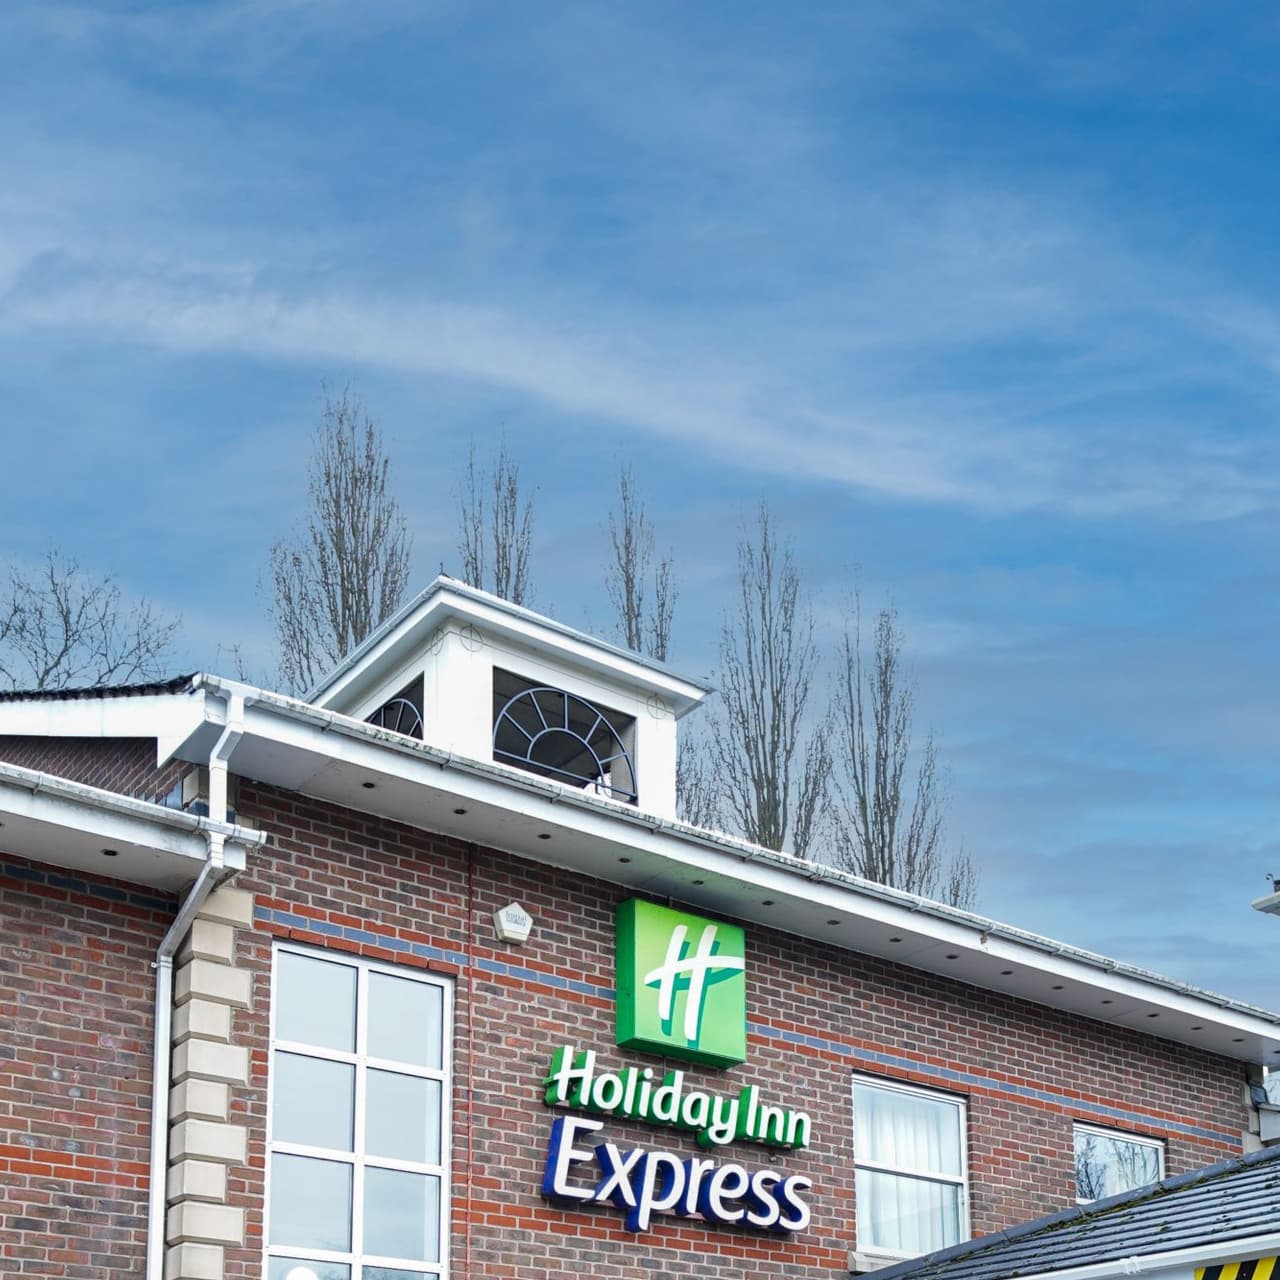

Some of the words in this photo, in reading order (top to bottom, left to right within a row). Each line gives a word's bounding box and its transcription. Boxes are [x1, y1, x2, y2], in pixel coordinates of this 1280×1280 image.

[553, 1045, 739, 1144] Holiday
[747, 1085, 811, 1146] Inn
[553, 1115, 812, 1232] Express
